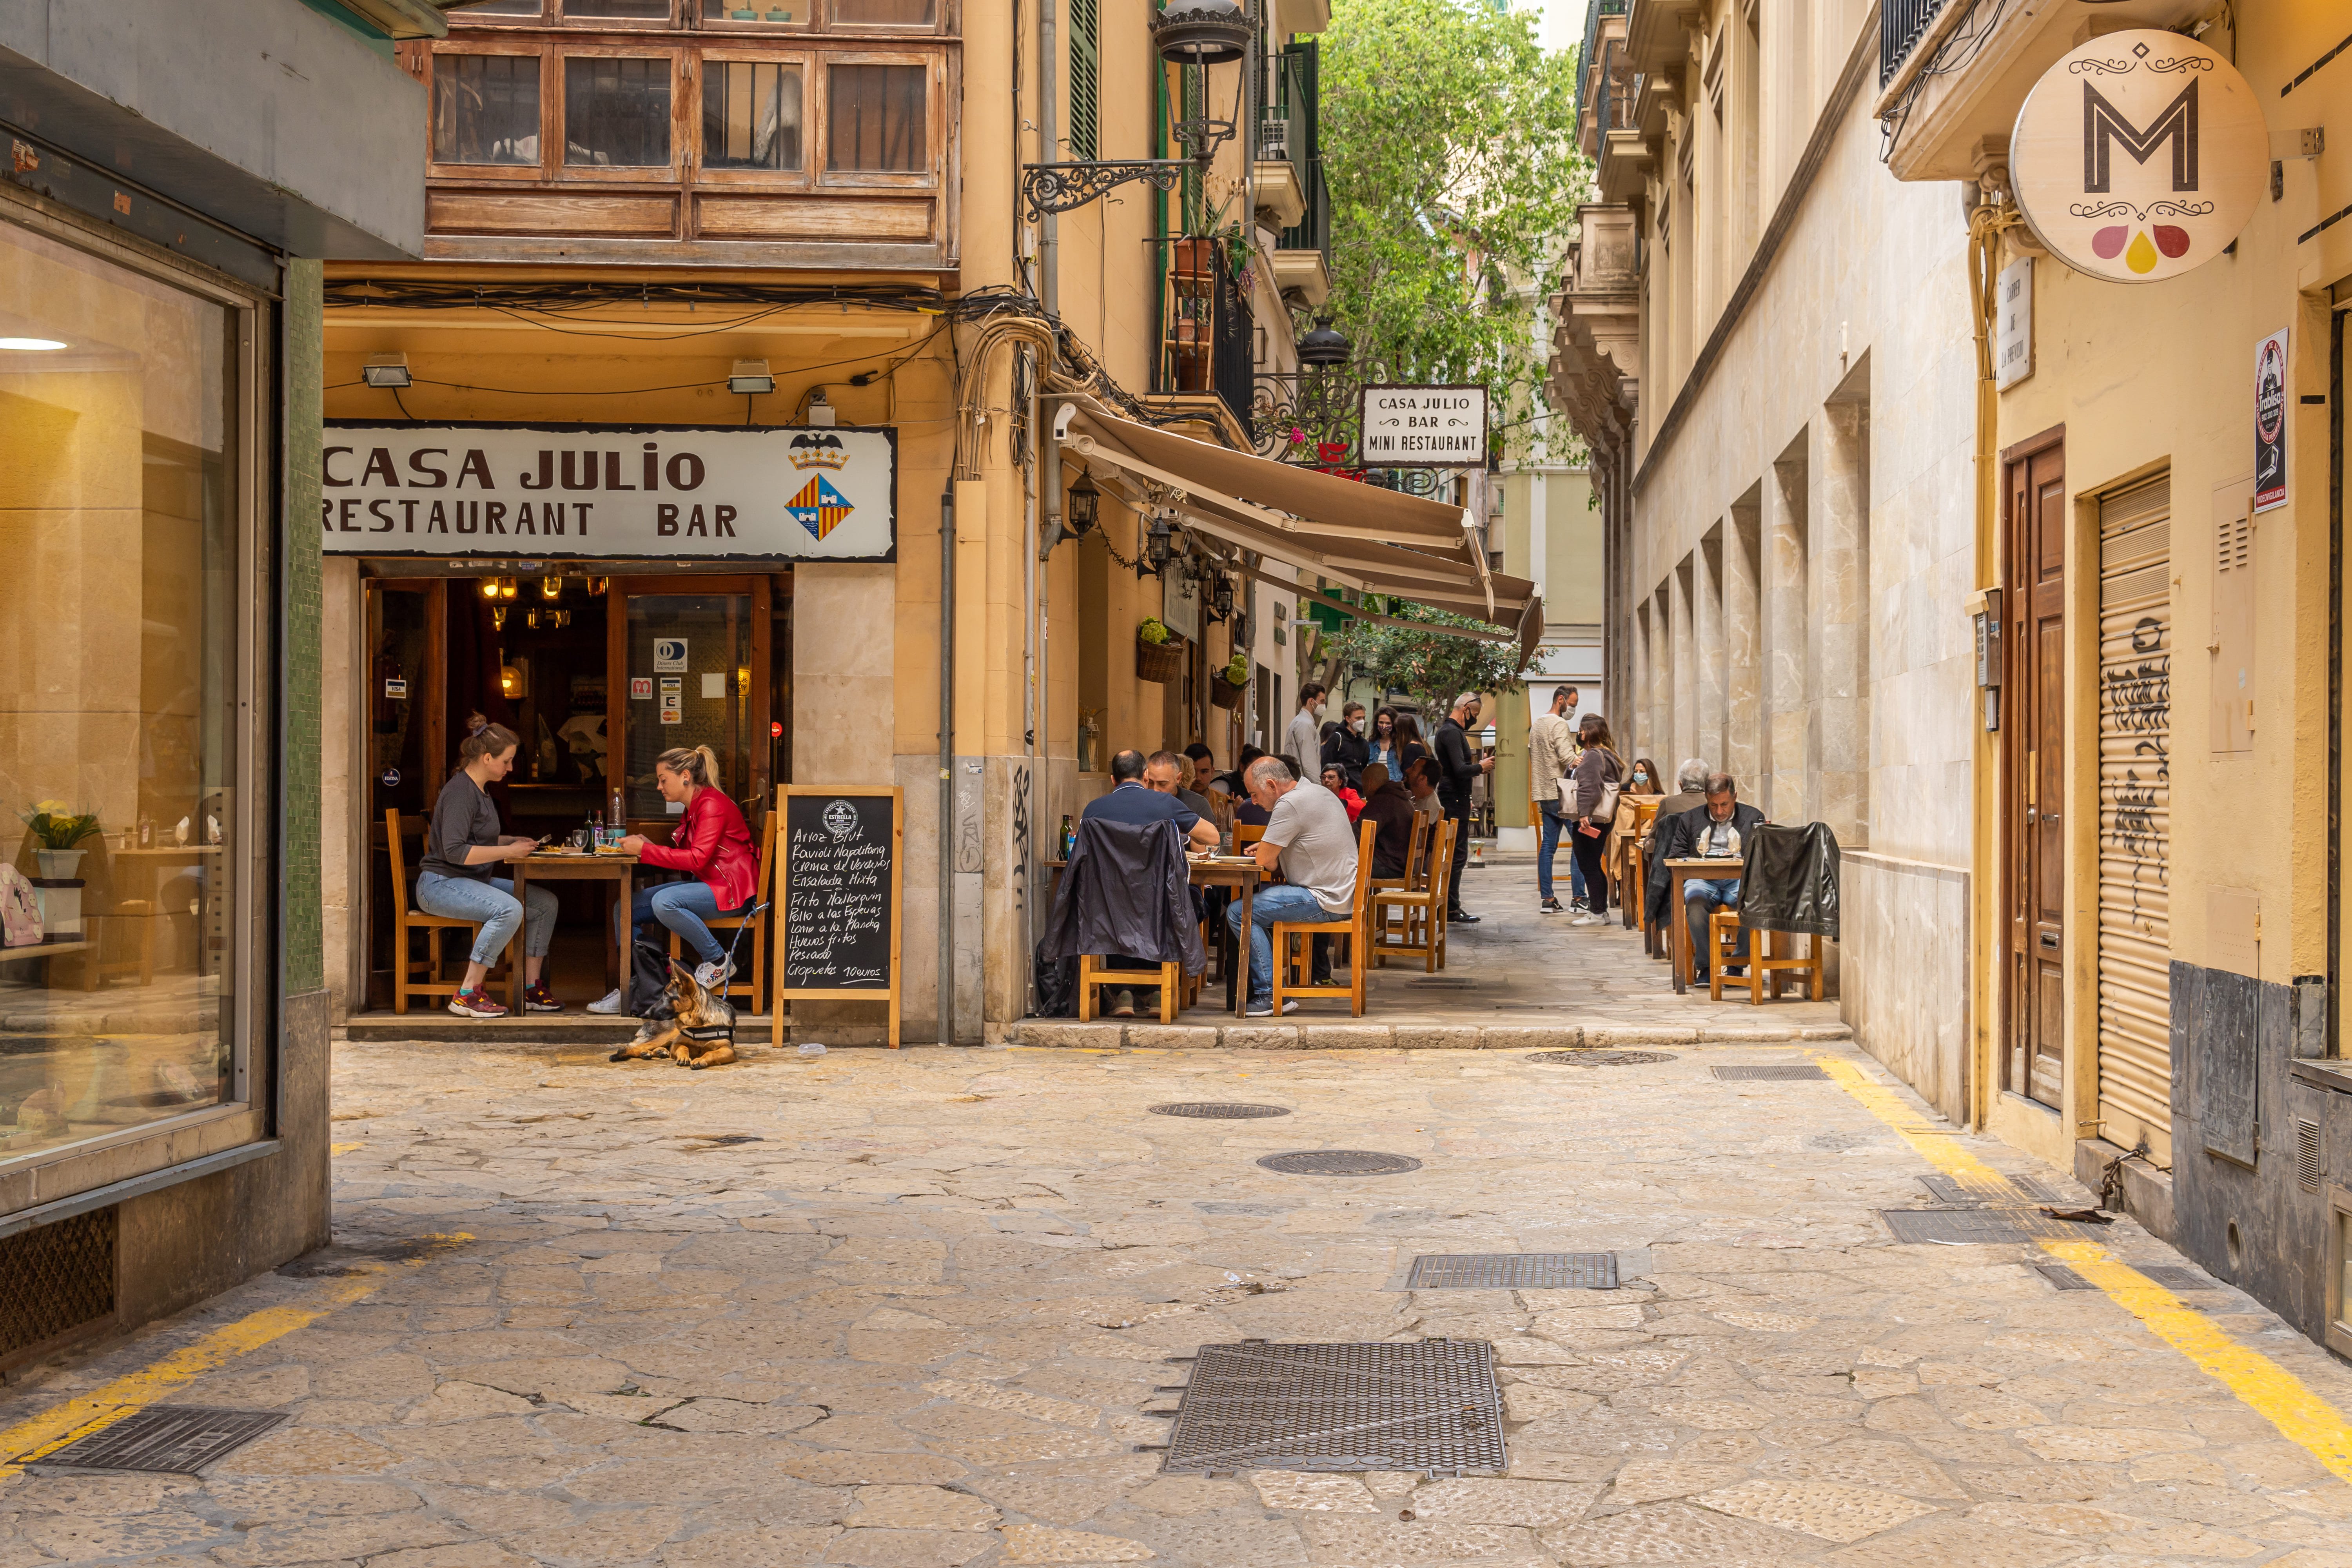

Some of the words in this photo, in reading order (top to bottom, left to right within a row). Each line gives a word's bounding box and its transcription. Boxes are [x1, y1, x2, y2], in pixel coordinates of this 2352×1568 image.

[2084, 75, 2198, 193] M
[2007, 279, 2020, 303] CARRER
[2011, 313, 2015, 332] DE
[2002, 352, 2006, 368] LA
[2257, 347, 2268, 383] CENTRAL
[2274, 343, 2283, 372] ALARMA
[1379, 398, 1417, 409] CASA
[1423, 398, 1470, 409] JULIO
[2259, 390, 2281, 412] Trablisa
[1408, 416, 1438, 427] BAR
[2256, 402, 2269, 441] VIGILANCIA
[2269, 391, 2283, 441] PERMANENTE
[1369, 436, 1395, 450] MINI
[1401, 436, 1477, 450] RESTAURANT
[323, 446, 495, 490] CASA
[2257, 489, 2285, 504] VIDEOVIGILANCIA
[657, 503, 737, 537] BAR
[793, 829, 827, 842] Arroz
[833, 826, 864, 844] Brut
[792, 844, 831, 860] Ravioli
[793, 861, 830, 872] Crema
[834, 860, 847, 871] de
[792, 874, 843, 887] Ensalada
[849, 869, 877, 886] Mixta
[791, 892, 819, 907] Frito
[789, 907, 812, 922] Pollo
[827, 909, 842, 918] las
[845, 905, 882, 919] Especias
[791, 923, 814, 933] Lomo
[830, 921, 841, 931] la
[846, 918, 880, 933] Plancha
[789, 935, 824, 949] Huevos
[827, 933, 856, 951] fritos
[789, 946, 831, 961] Pescado
[788, 961, 837, 985] Croquetas
